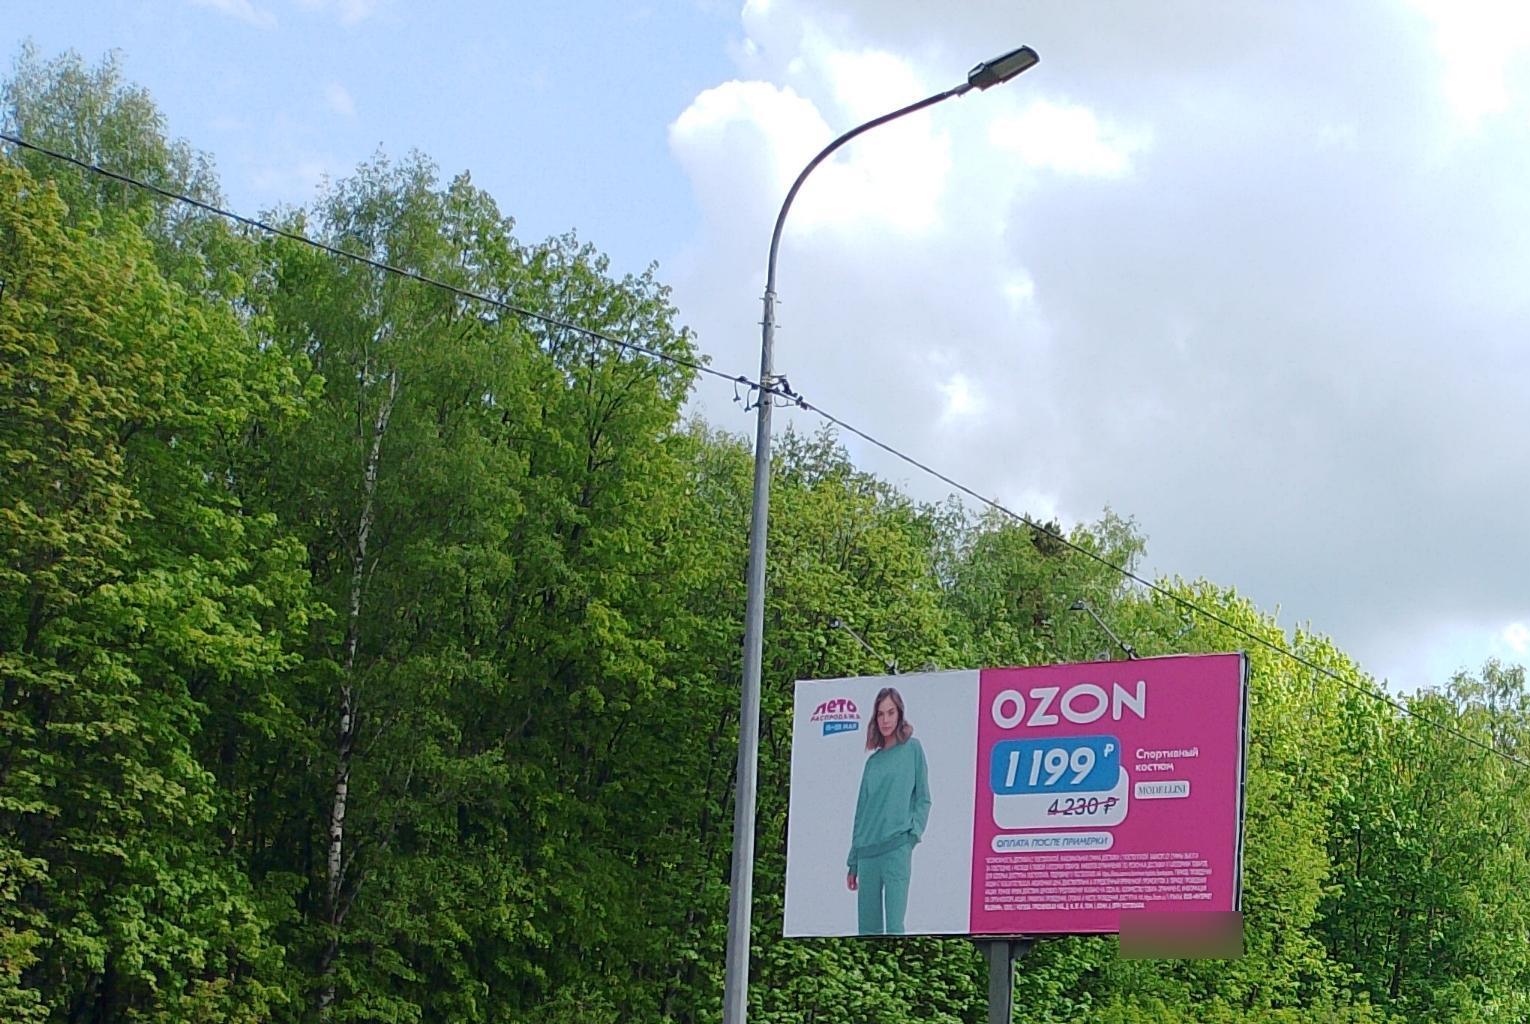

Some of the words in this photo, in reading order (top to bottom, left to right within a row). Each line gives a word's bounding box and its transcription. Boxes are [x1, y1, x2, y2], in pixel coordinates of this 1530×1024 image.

[991, 680, 1146, 729] OZON
[1136, 747, 1199, 760] Спортивный
[1135, 763, 1175, 772] костюм
[996, 839, 1029, 848] ОПЛАТА
[1031, 838, 1060, 847] ПОСЛЕ
[1062, 837, 1108, 846] ПРИМЕРКИ
